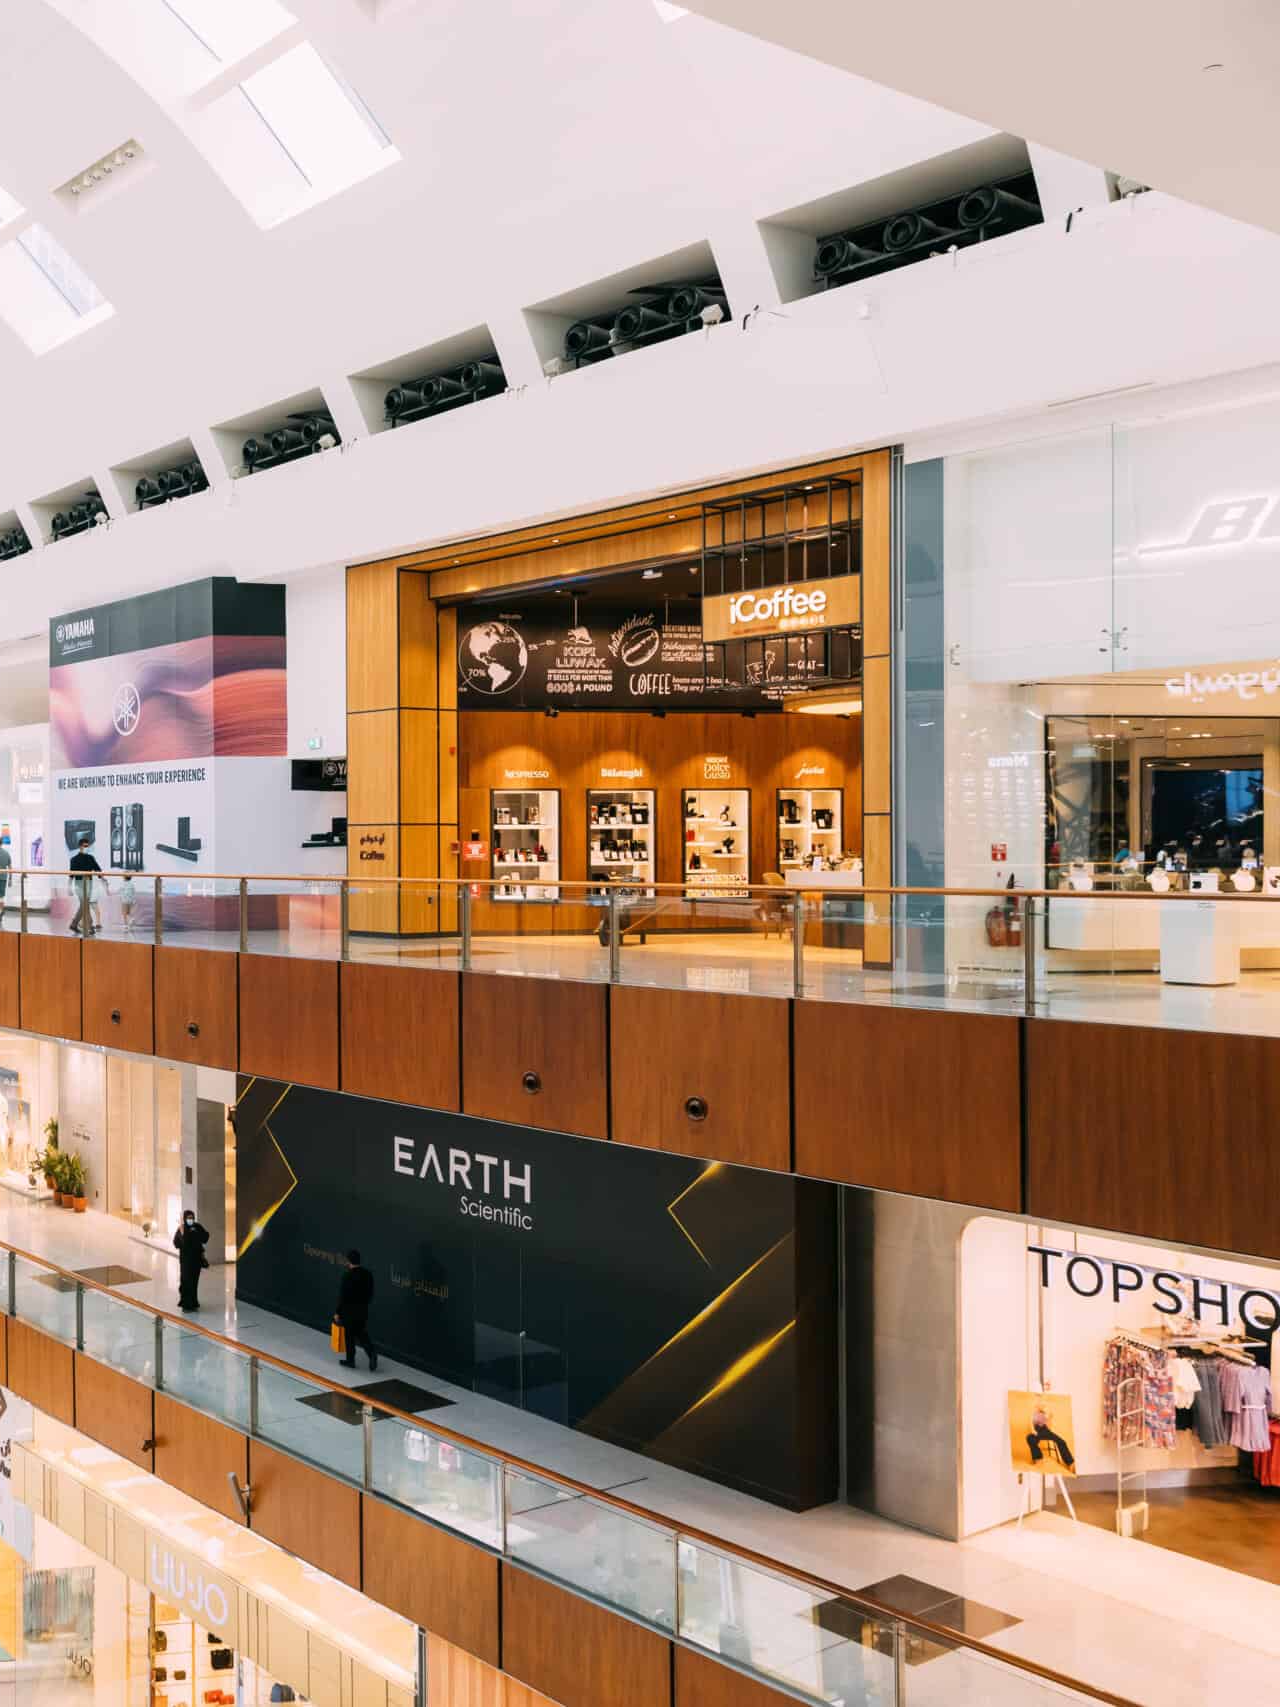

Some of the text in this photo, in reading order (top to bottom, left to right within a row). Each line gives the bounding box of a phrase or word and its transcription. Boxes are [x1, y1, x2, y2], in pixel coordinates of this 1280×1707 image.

[729, 588, 827, 625] iCoffee
[64, 618, 95, 641] YAMAHA
[468, 668, 487, 678] 70%
[629, 673, 672, 695] COFFEE
[576, 684, 582, 692] A
[583, 683, 613, 692] POUND
[58, 767, 206, 790] WE ARE WORKING TO ENHANCE YOUR EXPERIENCE
[393, 1134, 532, 1204] EARTH
[459, 1195, 534, 1232] Scientific
